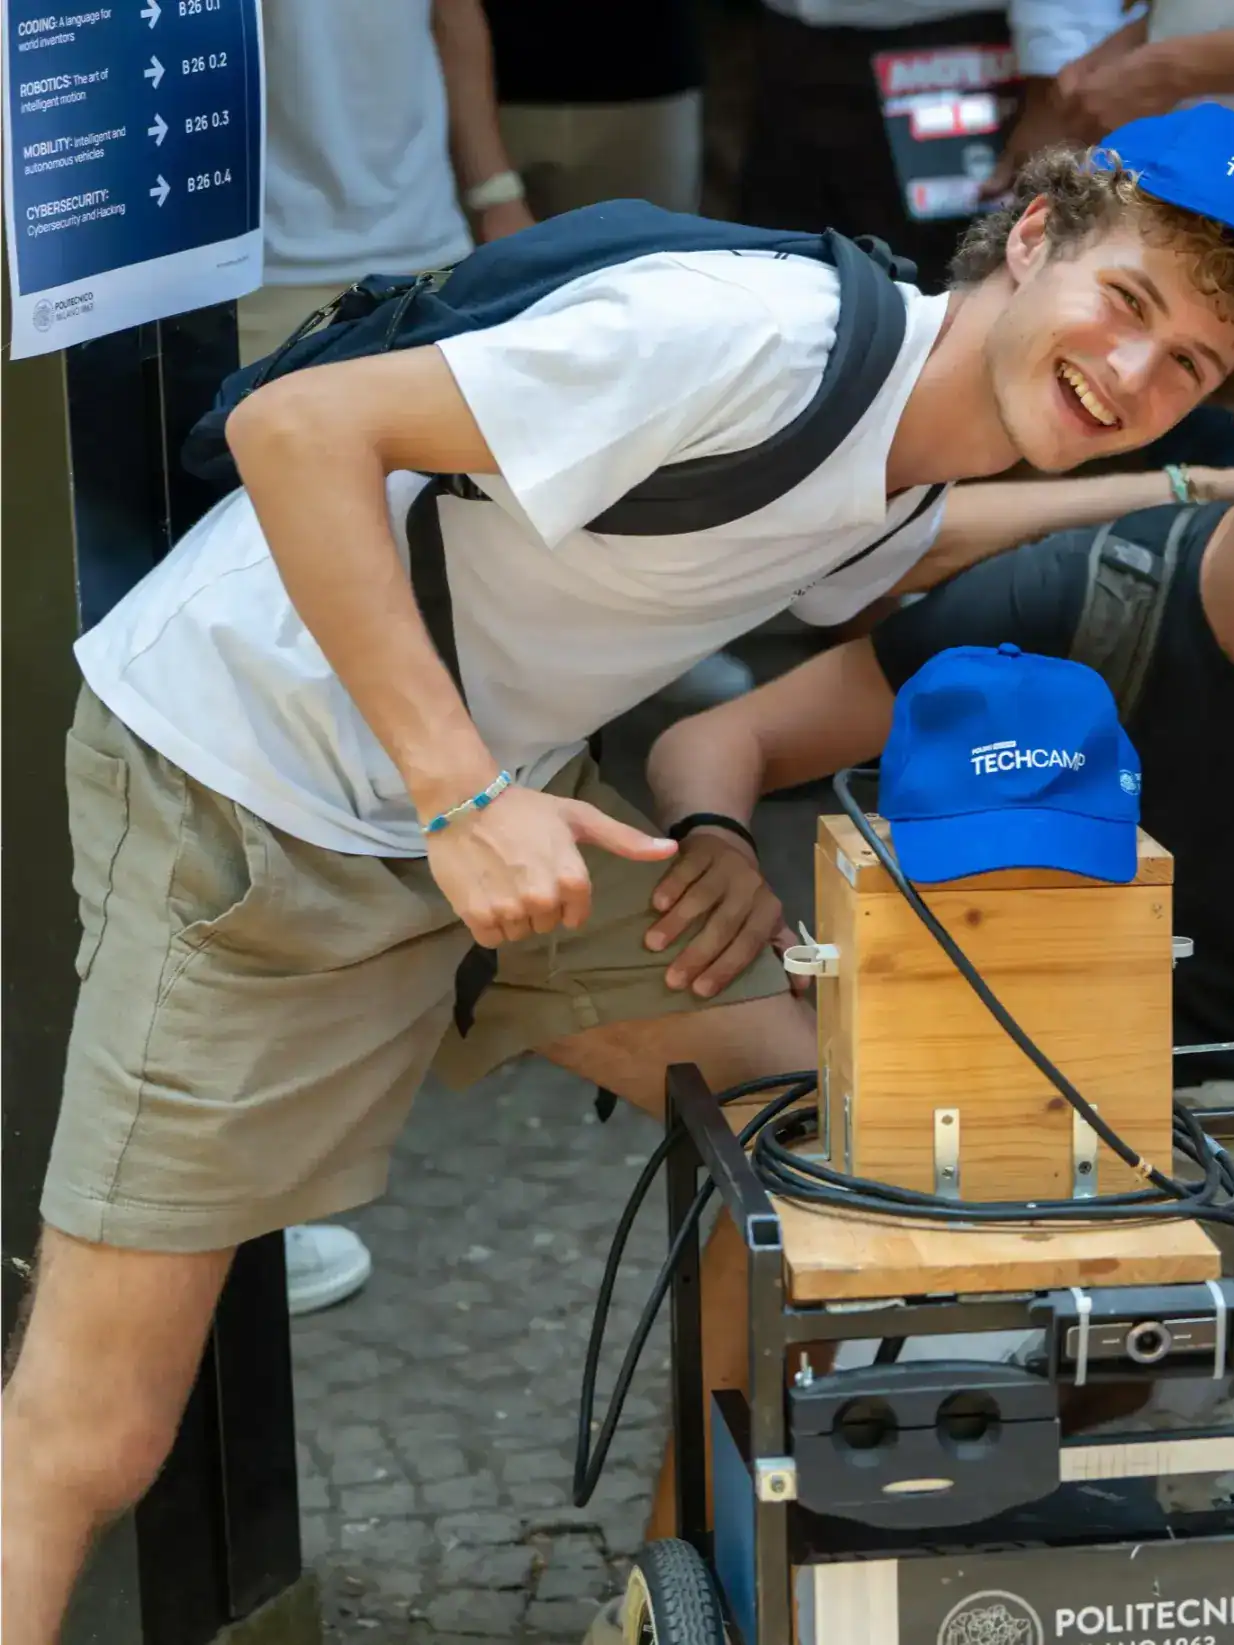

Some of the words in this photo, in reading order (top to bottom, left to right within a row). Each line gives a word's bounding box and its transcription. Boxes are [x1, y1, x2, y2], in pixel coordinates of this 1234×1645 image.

[18, 15, 57, 36] CODING:
[65, 10, 100, 27] language
[100, 8, 112, 20] for
[18, 37, 39, 52] world
[39, 32, 75, 48] inventors
[208, 51, 228, 69] 0.2
[20, 74, 72, 98] ROBOTICS:
[73, 74, 88, 86] The
[88, 71, 100, 83] art
[100, 67, 109, 80] of
[21, 96, 59, 114] intelligent
[60, 91, 87, 105] motion
[212, 110, 230, 128] 0.3
[23, 137, 73, 159] MOBILITY:
[111, 126, 126, 138] and
[24, 156, 73, 175] autonomous
[74, 148, 104, 163] vehicles
[214, 168, 232, 186] 0.4
[26, 188, 109, 220] CYBERSECURITY:
[27, 214, 81, 238] Cybersecurity
[81, 209, 96, 222] and
[96, 204, 126, 218] Hacking
[970, 749, 1086, 775] TECHCAMP
